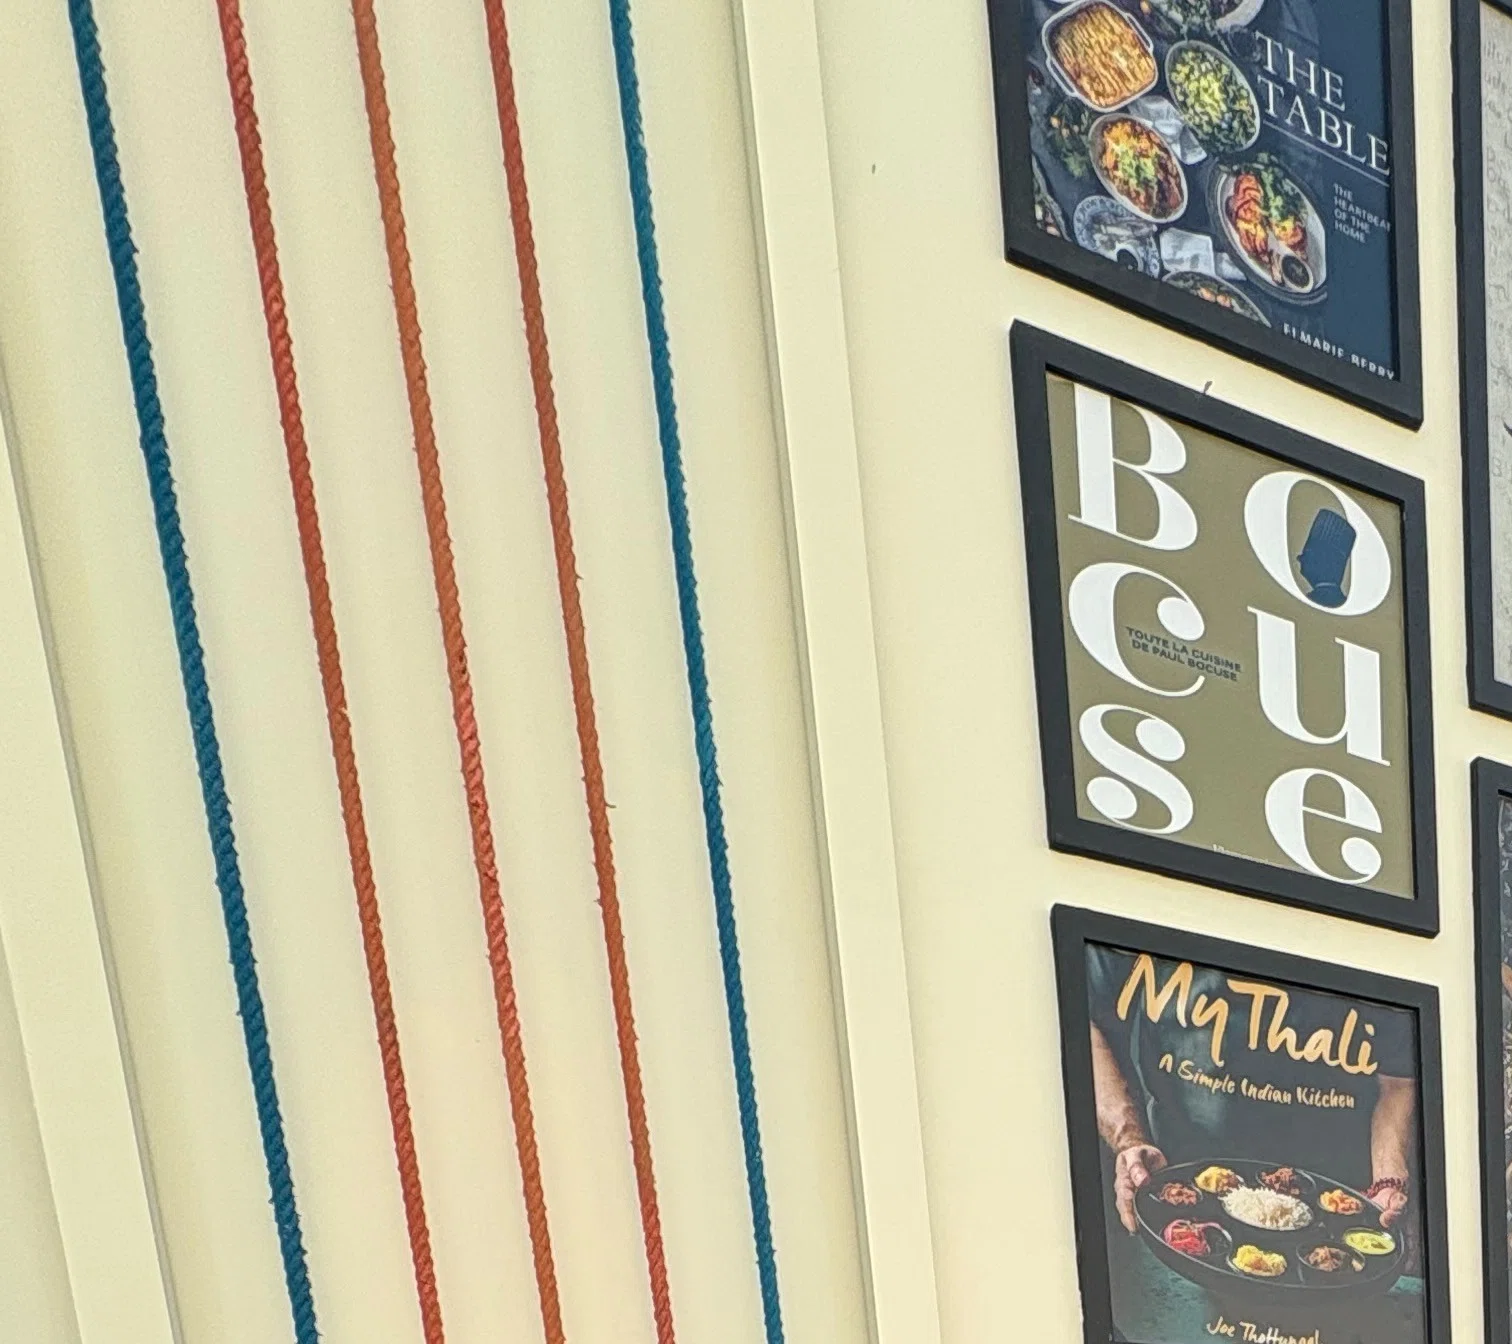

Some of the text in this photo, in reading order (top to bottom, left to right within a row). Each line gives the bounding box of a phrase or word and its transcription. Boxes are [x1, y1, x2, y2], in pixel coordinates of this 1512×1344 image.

[1255, 30, 1346, 112] THE
[1257, 74, 1390, 176] TABLE
[1126, 626, 1242, 673] TOUTE LA CUISINE
[1132, 639, 1237, 681] DE PAUL BOCUSE
[1117, 953, 1378, 1075] My Thali
[1177, 1059, 1235, 1094] Simple
[1241, 1078, 1292, 1105] Indian
[1296, 1087, 1355, 1109] Kitchen
[1206, 1316, 1235, 1337] Joe
